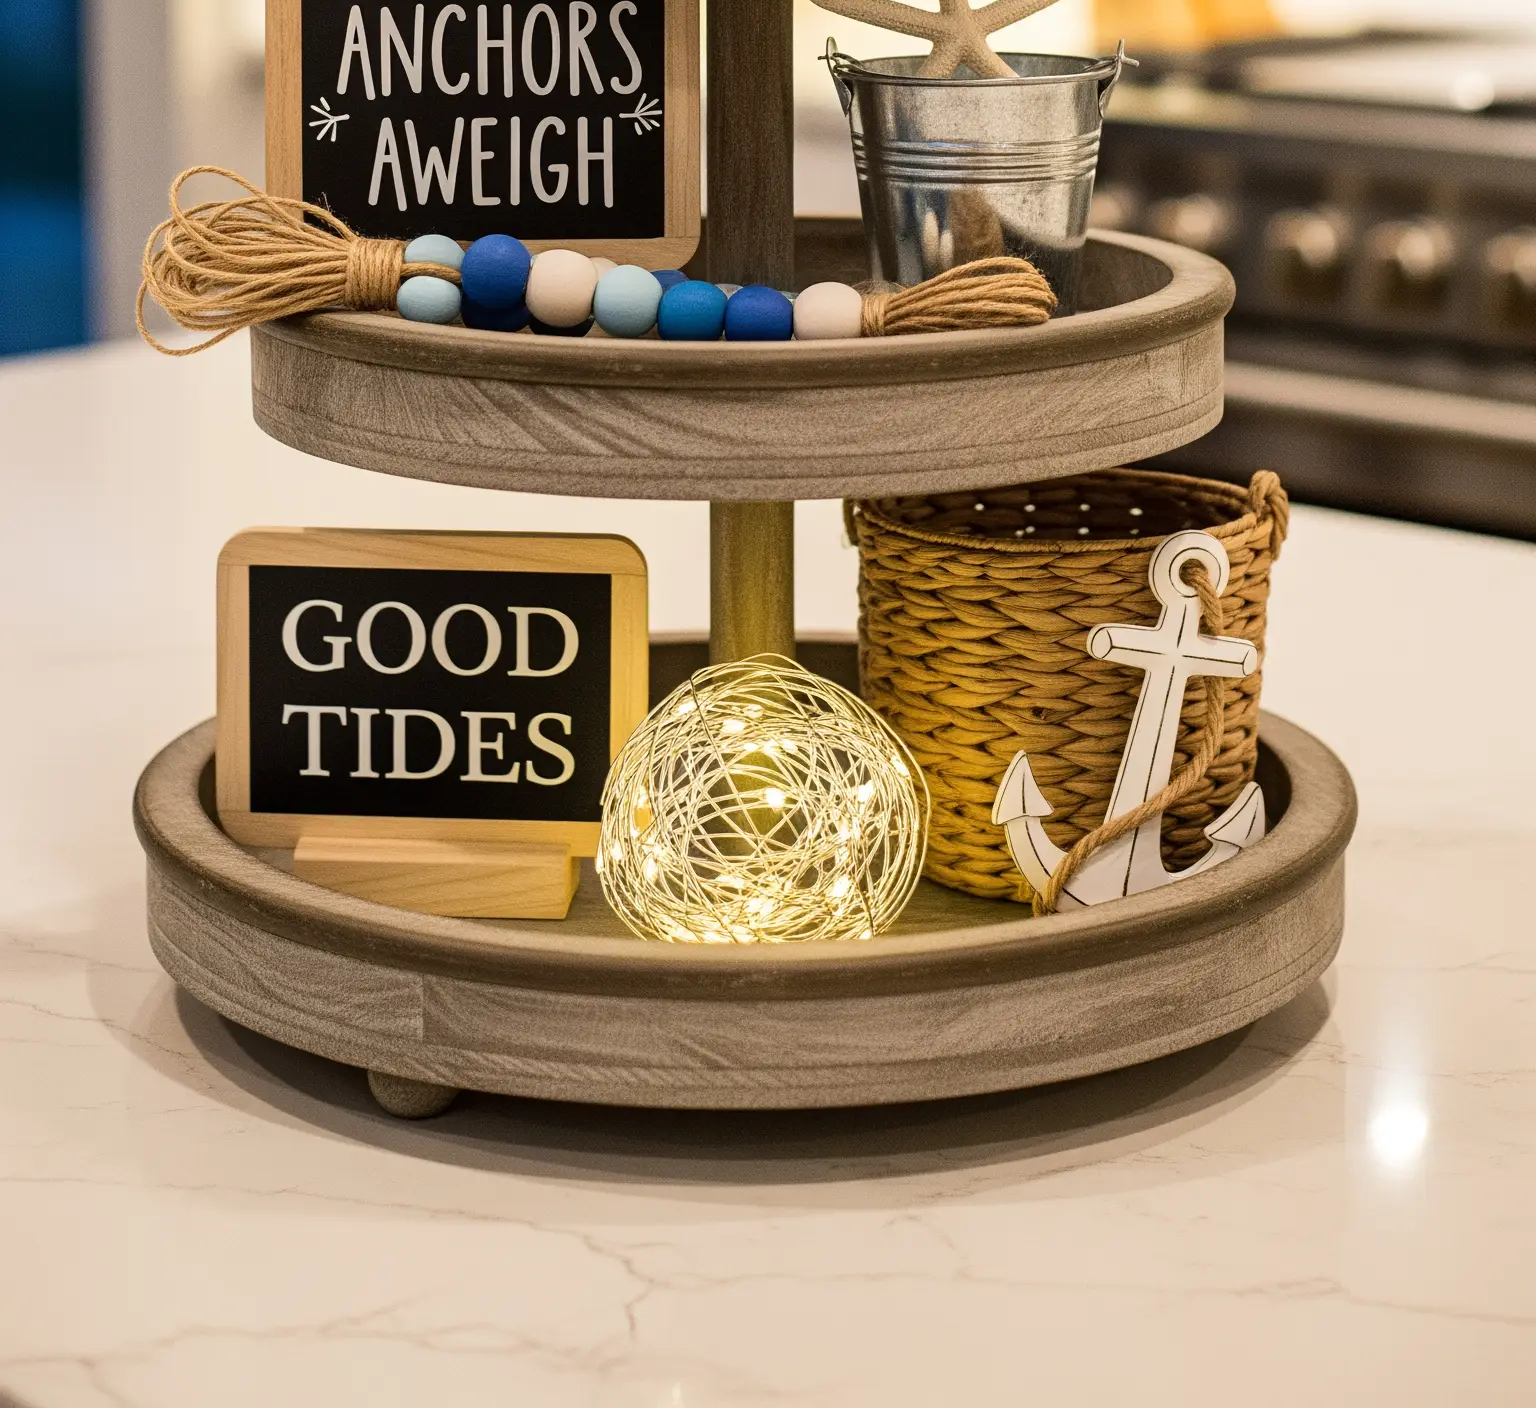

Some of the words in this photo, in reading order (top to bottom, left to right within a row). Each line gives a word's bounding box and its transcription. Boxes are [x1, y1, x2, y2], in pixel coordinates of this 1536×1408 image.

[336, 0, 643, 101] ANCHORS
[368, 116, 614, 212] AWEIGH
[281, 599, 580, 677] GOOD
[281, 703, 576, 786] TIDES
